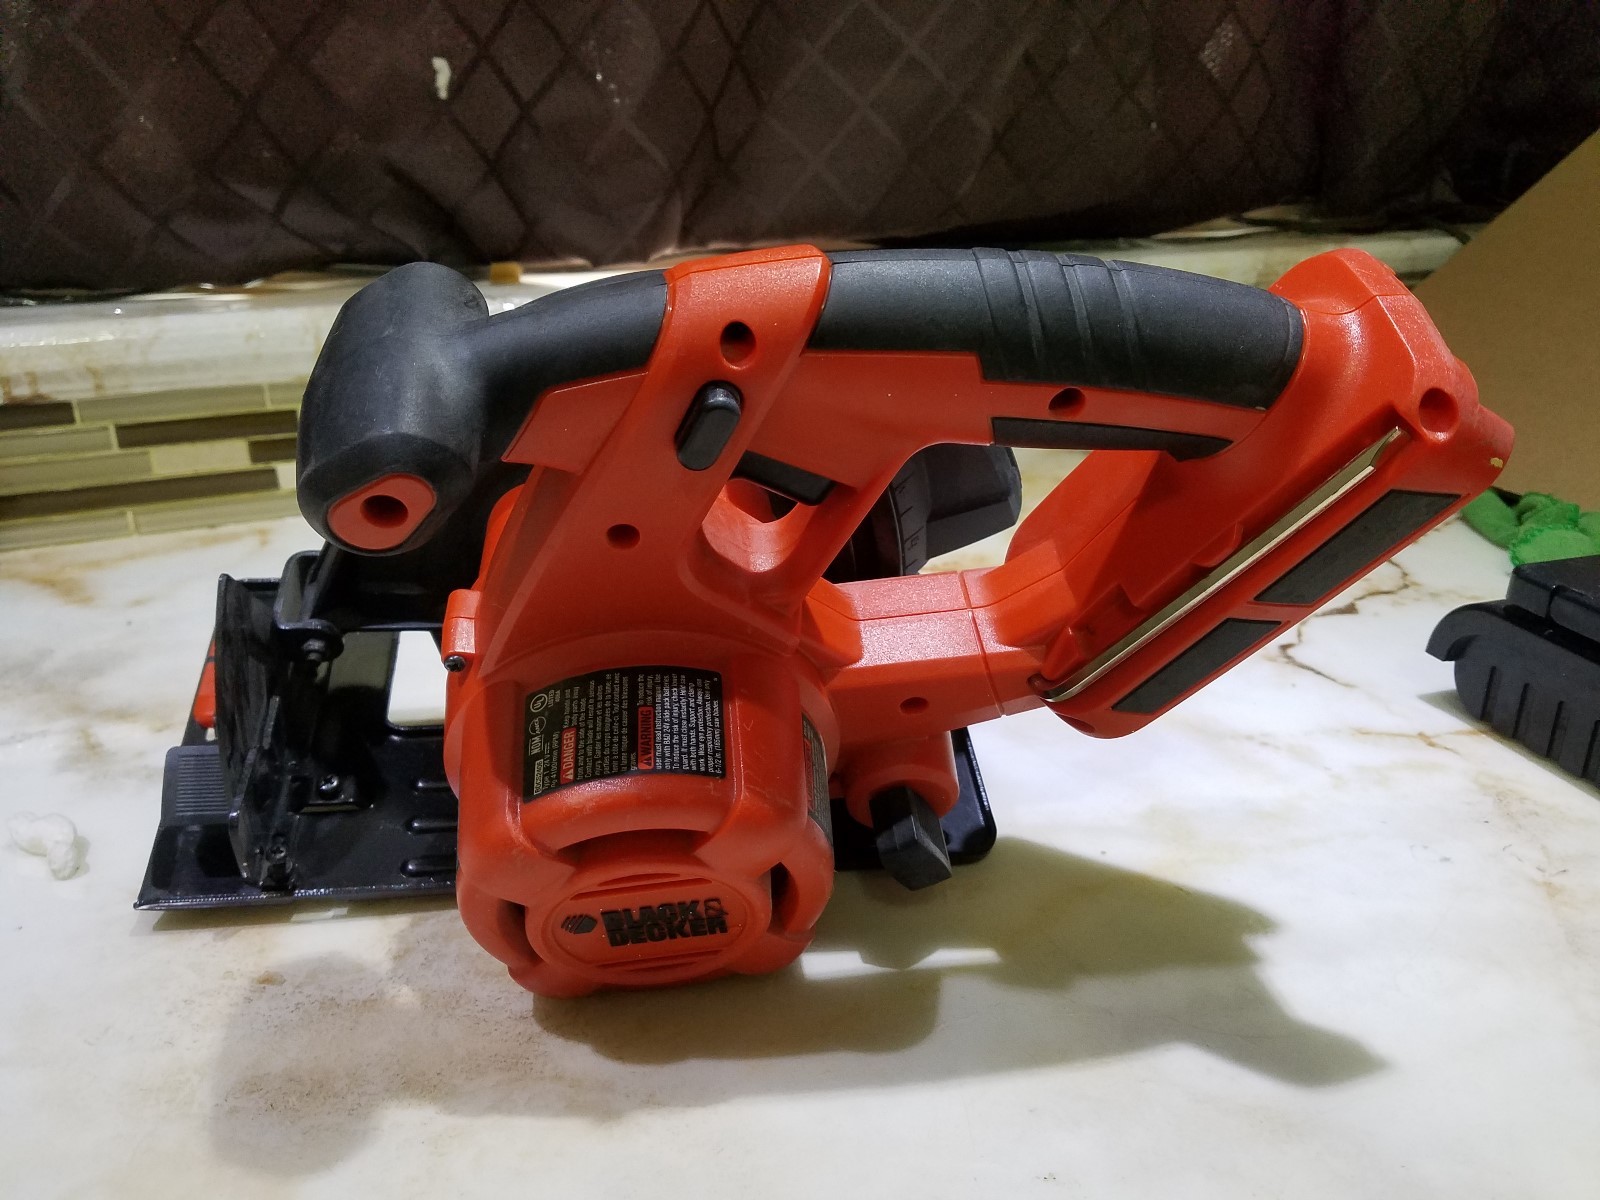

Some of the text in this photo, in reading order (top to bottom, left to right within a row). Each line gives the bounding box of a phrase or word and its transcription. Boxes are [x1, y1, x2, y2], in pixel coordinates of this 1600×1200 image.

[662, 696, 671, 709] pack
[680, 720, 688, 734] close
[688, 708, 697, 728] Support
[640, 710, 652, 756] WARNING
[698, 732, 706, 742] eye
[531, 734, 541, 755] NOM
[562, 730, 575, 770] DANGER
[697, 742, 705, 756] Wear
[663, 757, 672, 770] only
[601, 900, 701, 930] BLACK
[606, 917, 729, 947] DECKER
